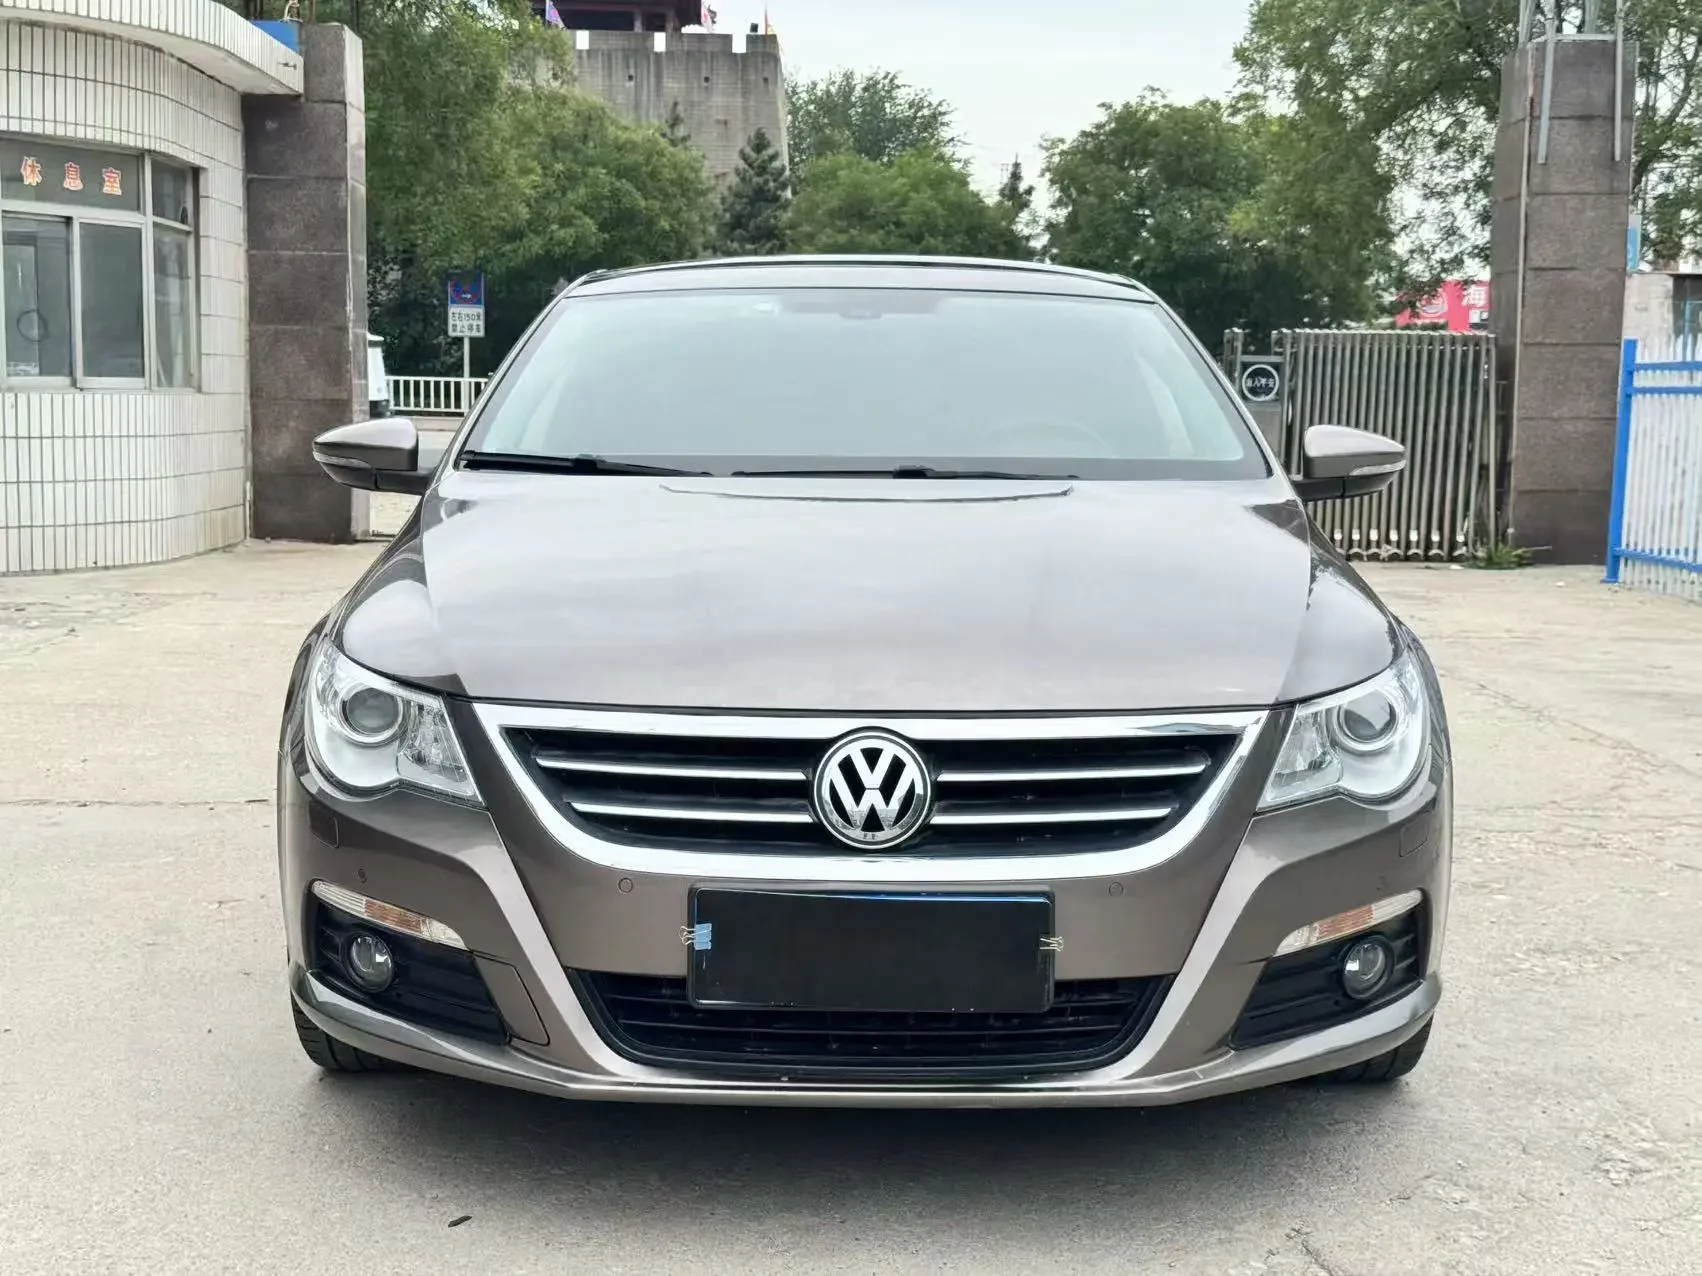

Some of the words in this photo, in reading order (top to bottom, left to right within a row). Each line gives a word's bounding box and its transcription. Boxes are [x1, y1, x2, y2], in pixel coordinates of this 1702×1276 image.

[20, 156, 122, 196] 休息室
[820, 737, 925, 842] VW
